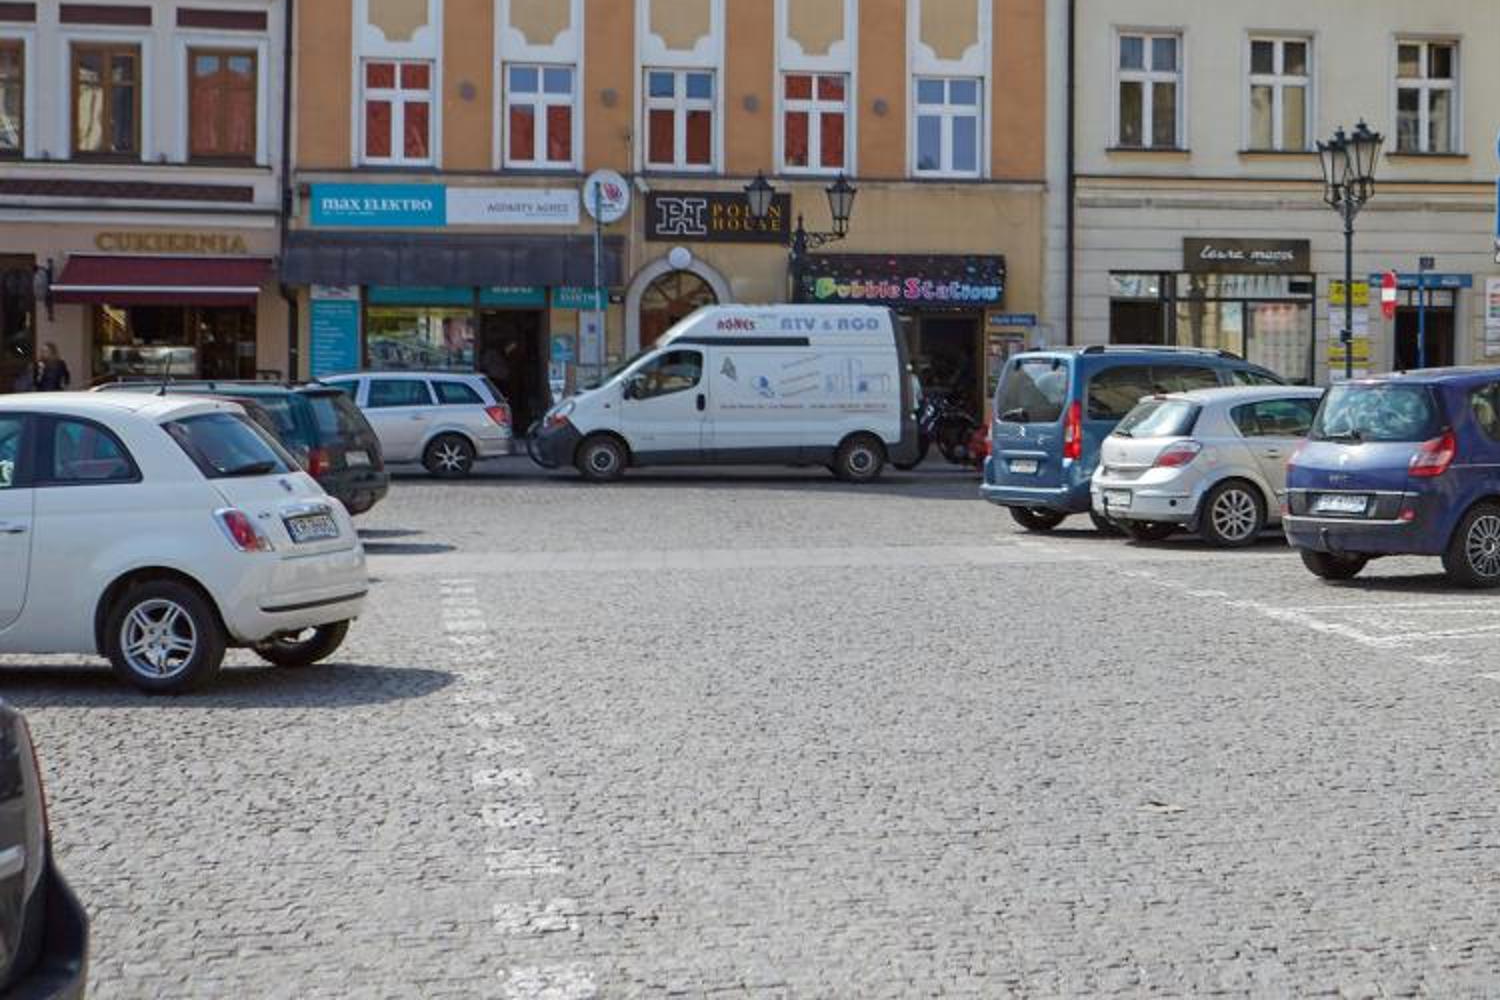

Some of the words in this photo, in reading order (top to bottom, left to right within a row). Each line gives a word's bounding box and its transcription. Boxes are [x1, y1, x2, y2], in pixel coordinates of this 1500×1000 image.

[363, 199, 433, 212] ELEKTRO
[96, 231, 248, 253] CUKIERNIA
[904, 277, 1001, 299] Station
